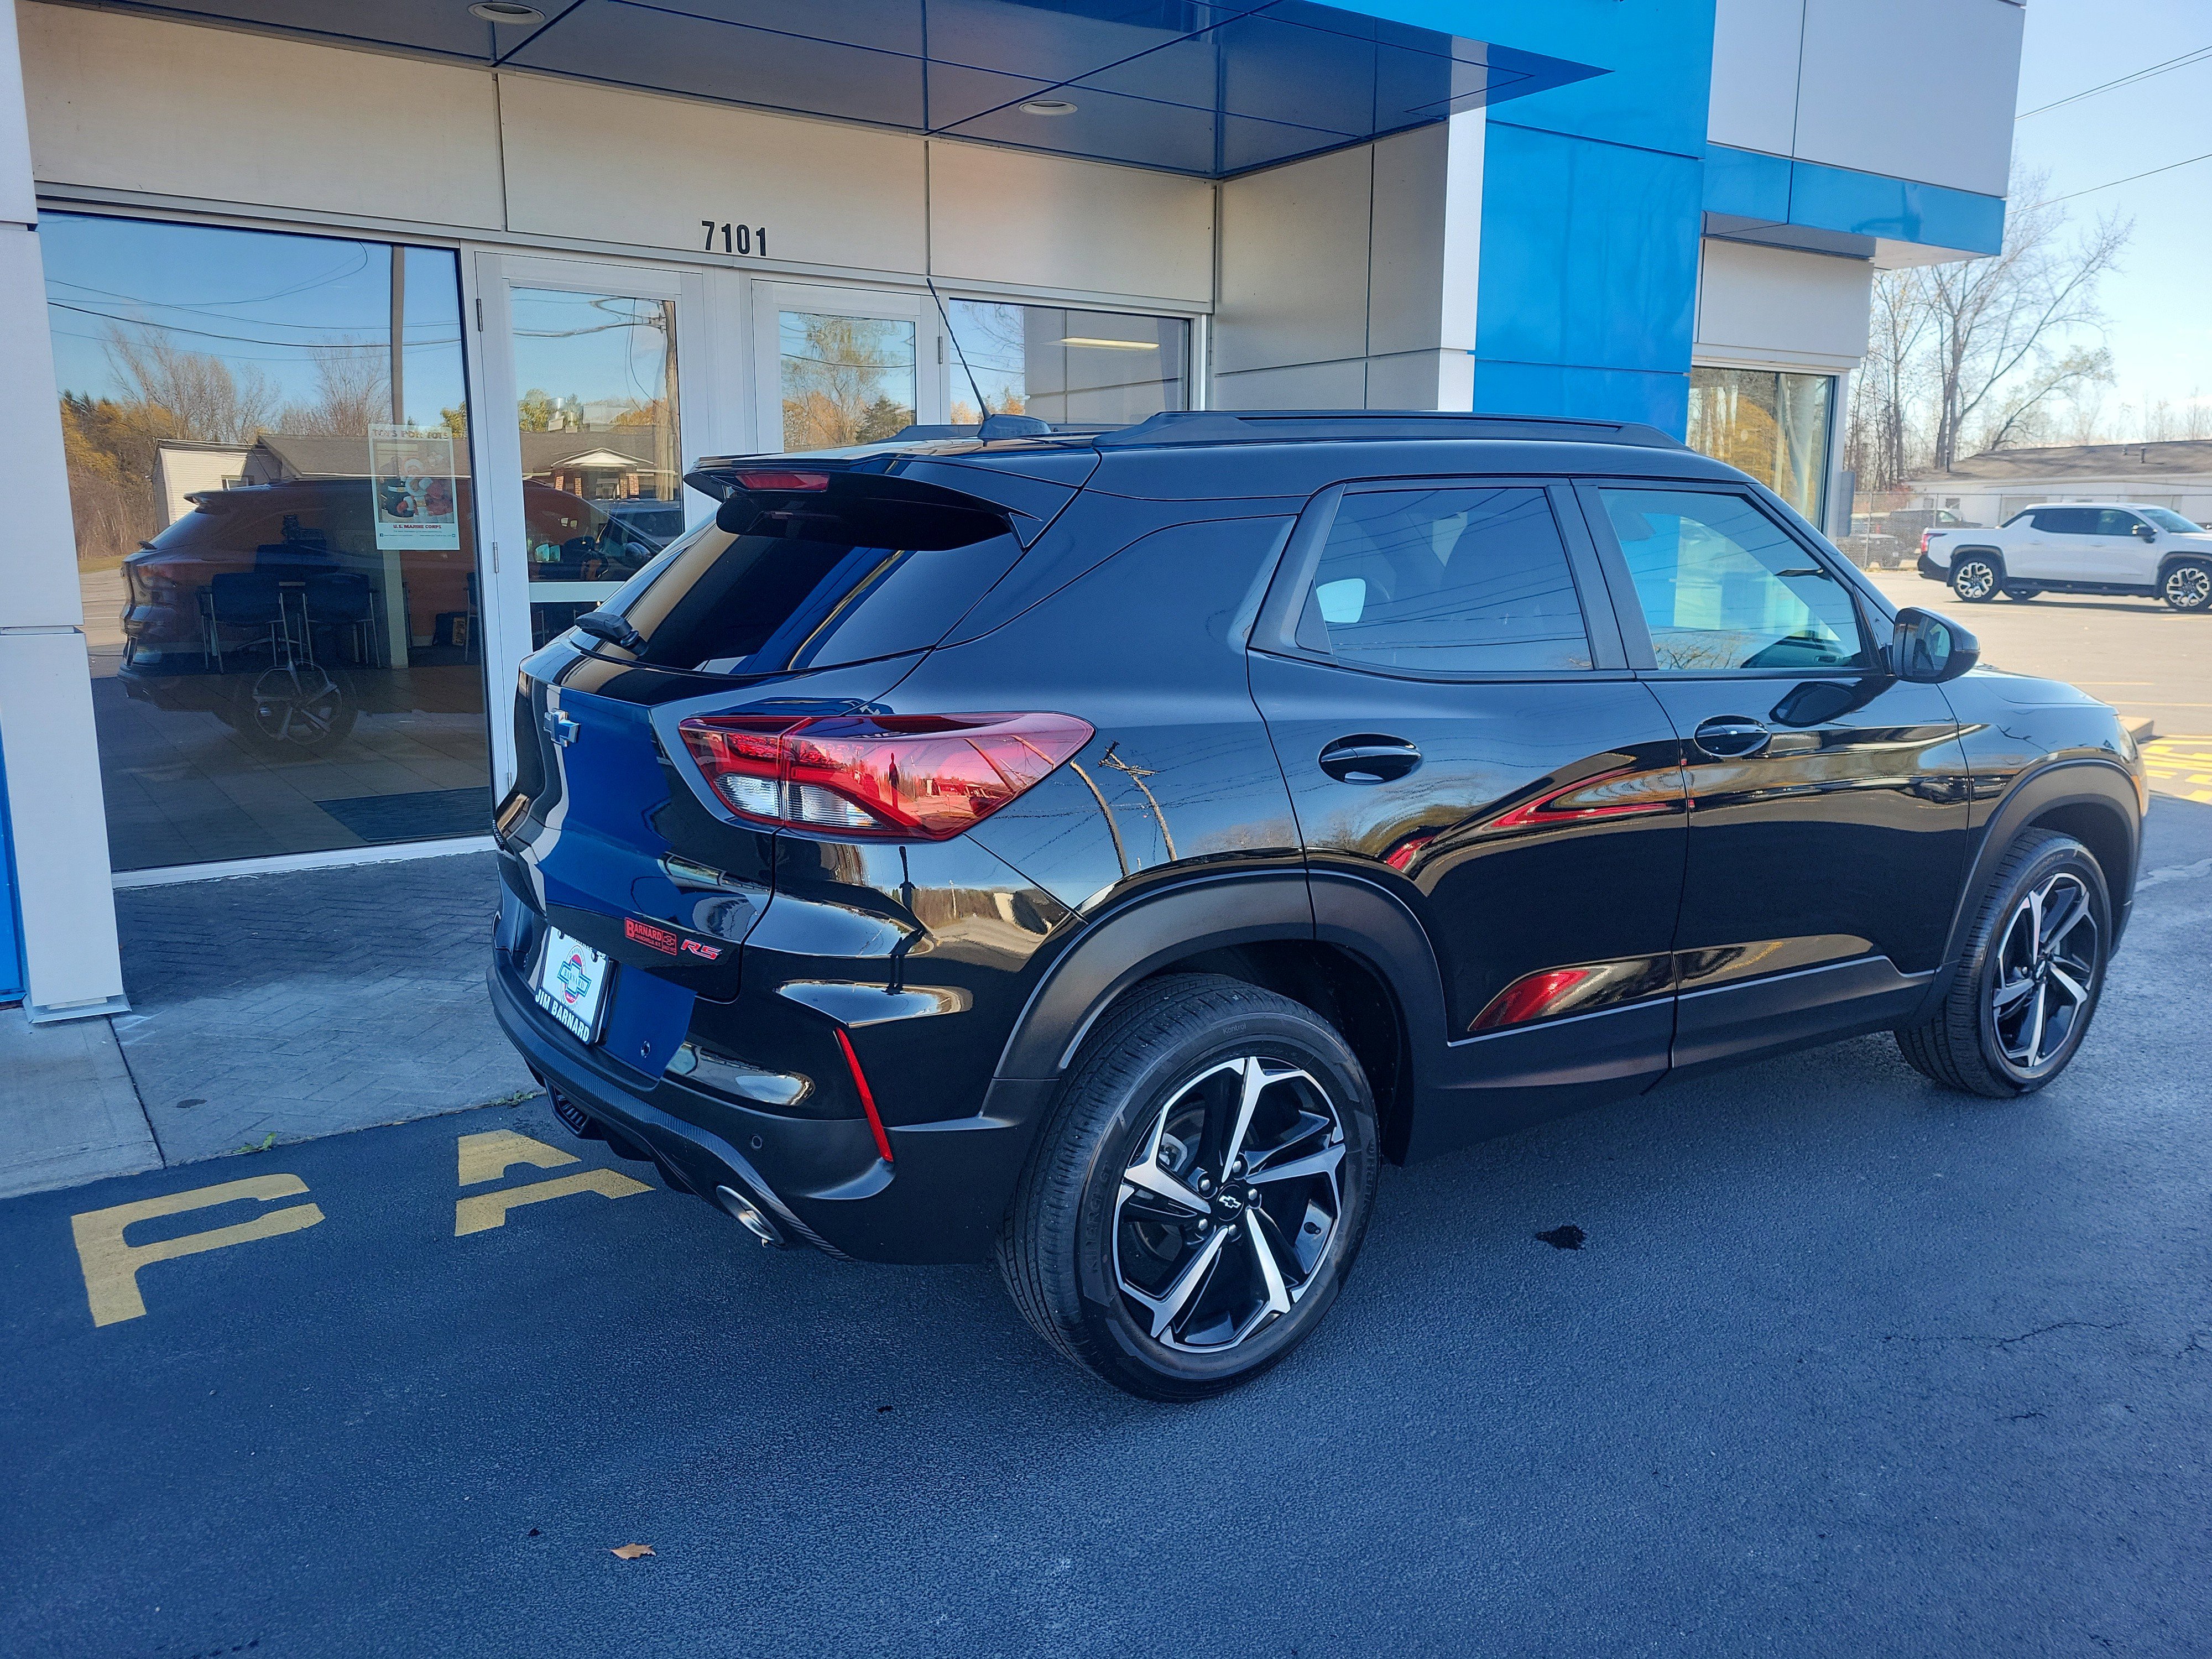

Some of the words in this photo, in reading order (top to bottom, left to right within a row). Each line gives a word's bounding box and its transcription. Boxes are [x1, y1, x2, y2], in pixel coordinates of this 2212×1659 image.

[701, 220, 766, 257] 7101
[372, 429, 397, 437] TOYS
[626, 920, 662, 941] BARNARD
[681, 938, 723, 959] RS
[564, 968, 585, 989] BARNARD
[535, 989, 551, 1010] JIM
[551, 1001, 590, 1042] BARNARD
[1223, 1022, 1246, 1034] Kontrol
